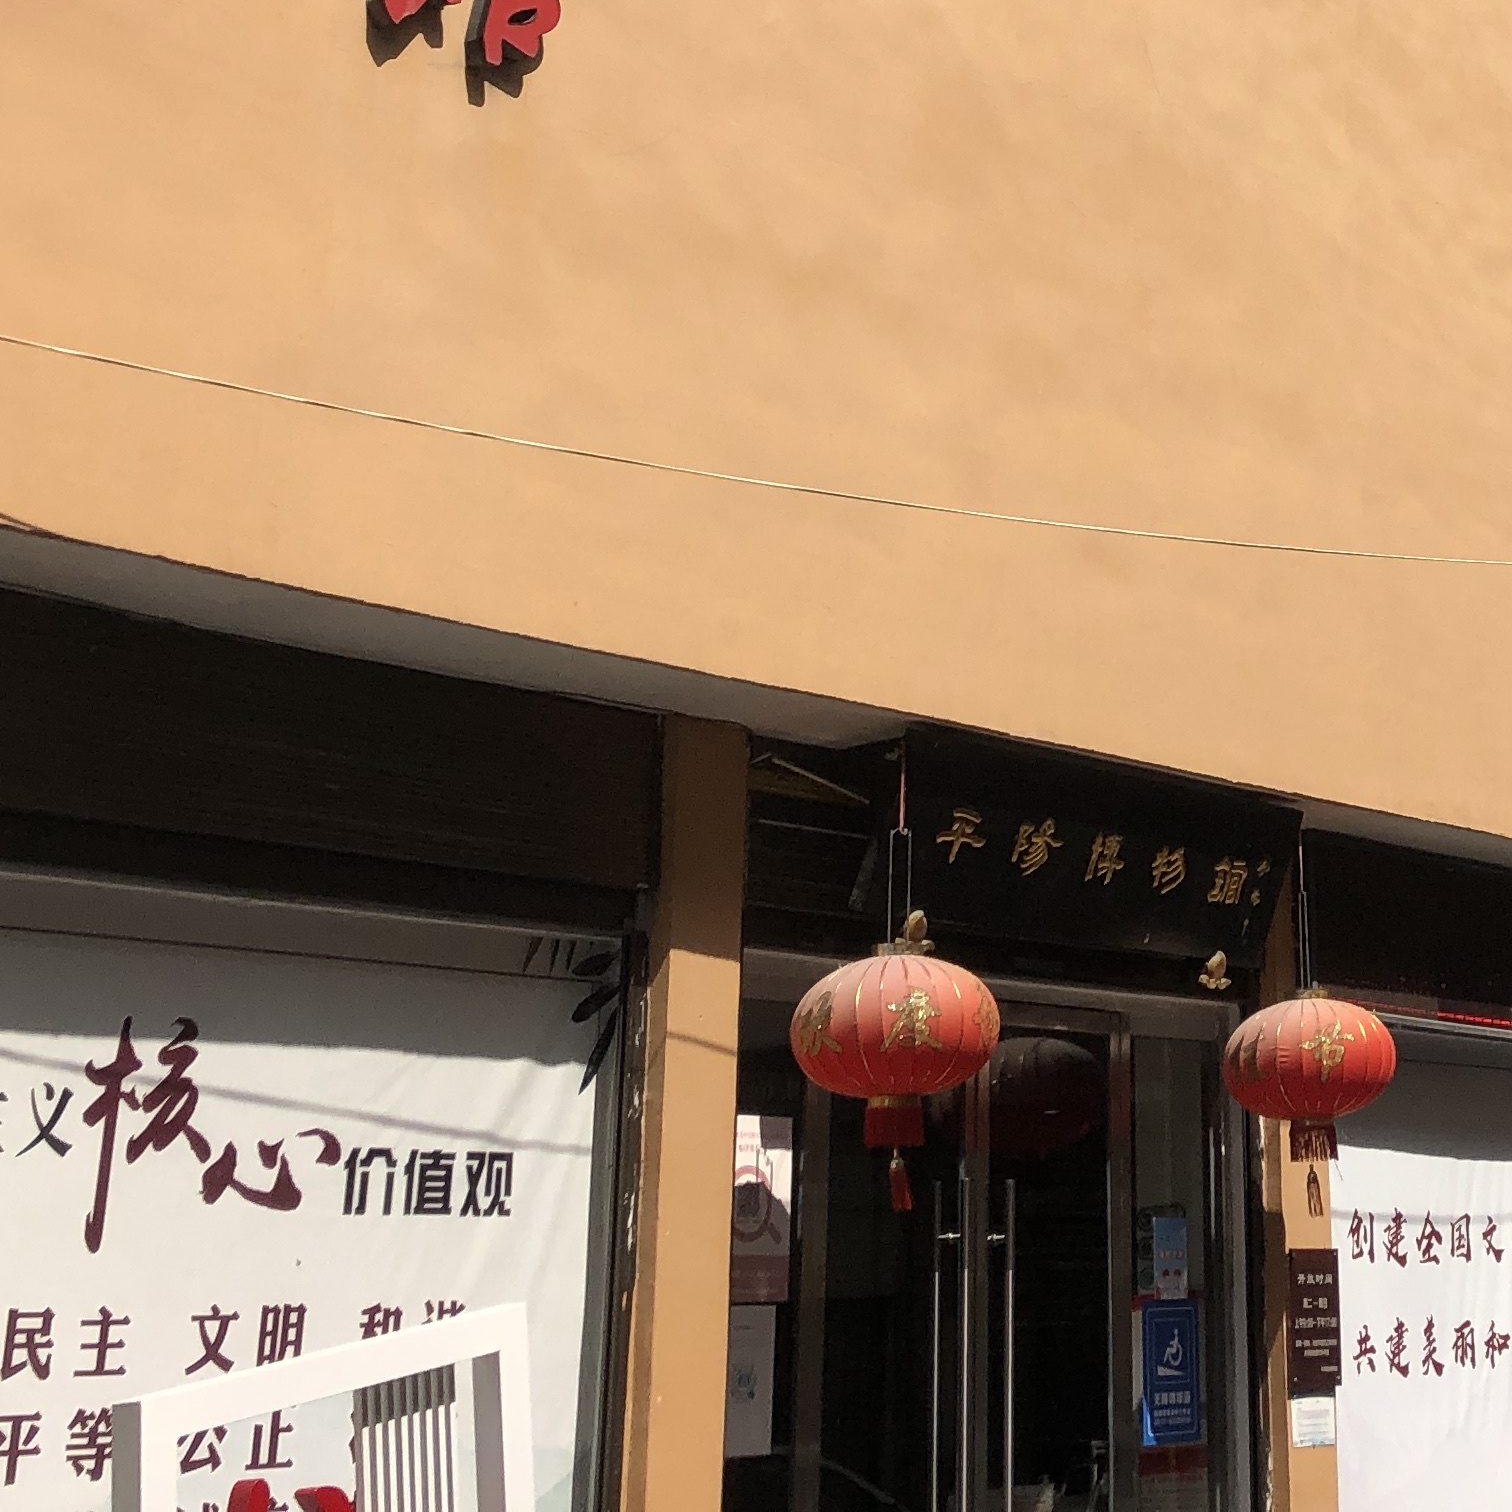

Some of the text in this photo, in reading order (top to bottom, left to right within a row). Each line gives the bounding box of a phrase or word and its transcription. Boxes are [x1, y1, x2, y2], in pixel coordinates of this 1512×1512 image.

[0, 1015, 515, 1254] 义核心价值观
[1, 1306, 131, 1381] 民主
[185, 1303, 307, 1374] 文明
